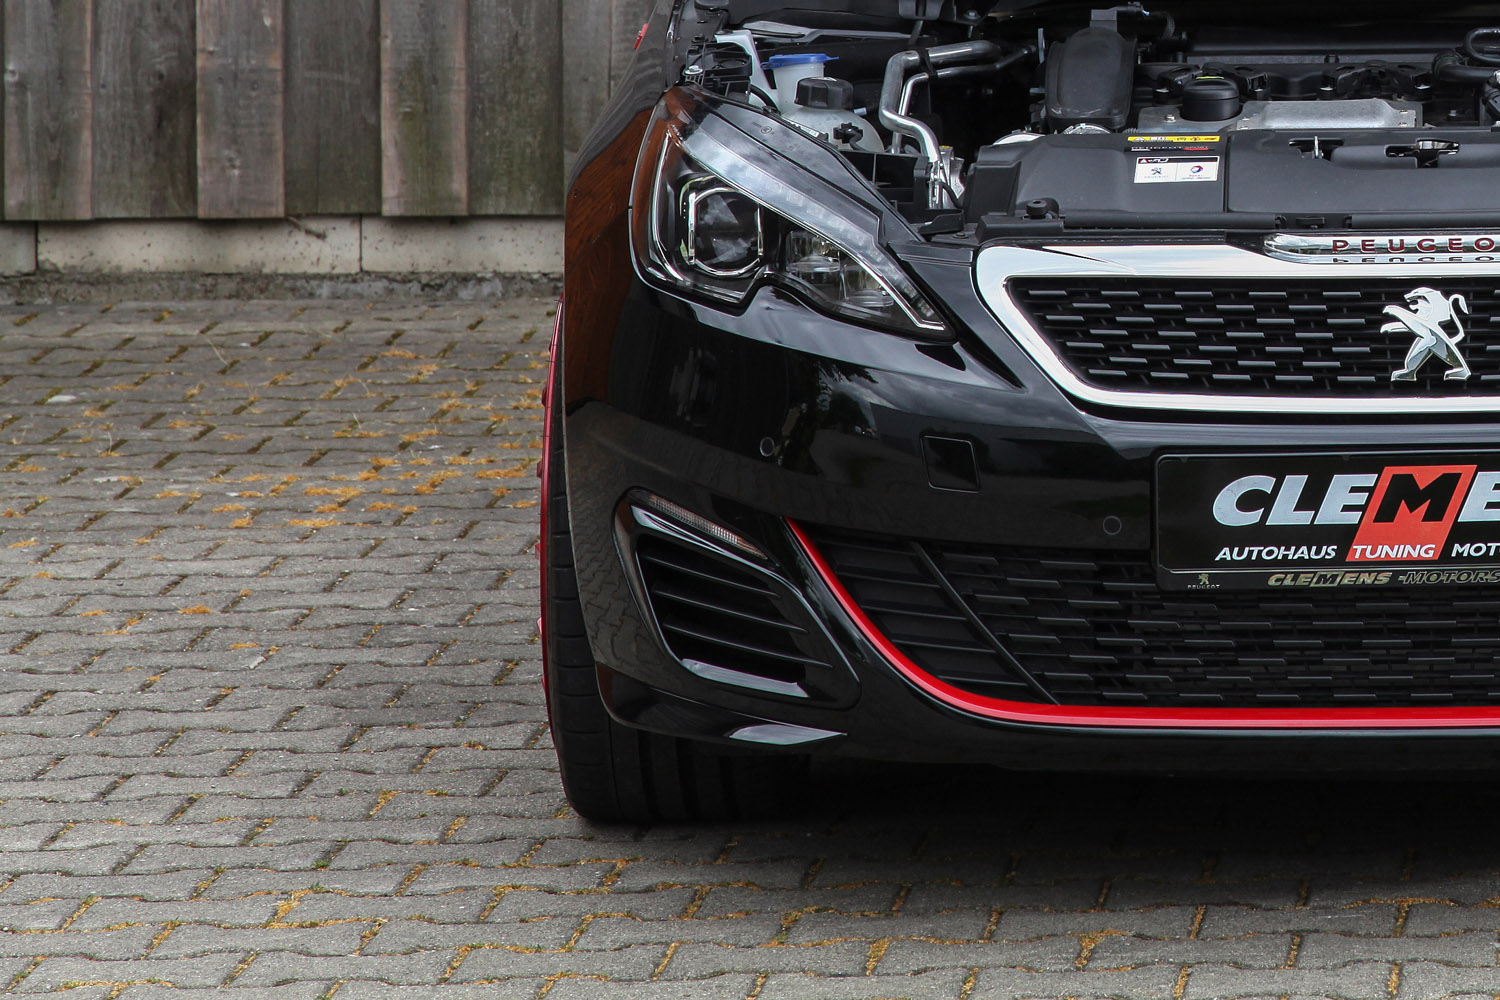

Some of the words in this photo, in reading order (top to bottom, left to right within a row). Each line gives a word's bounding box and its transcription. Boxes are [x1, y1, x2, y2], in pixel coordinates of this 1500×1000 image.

[1214, 544, 1337, 561] AUTOHAUS
[1352, 543, 1436, 559] TUNING
[1267, 571, 1392, 588] CLEMENS
